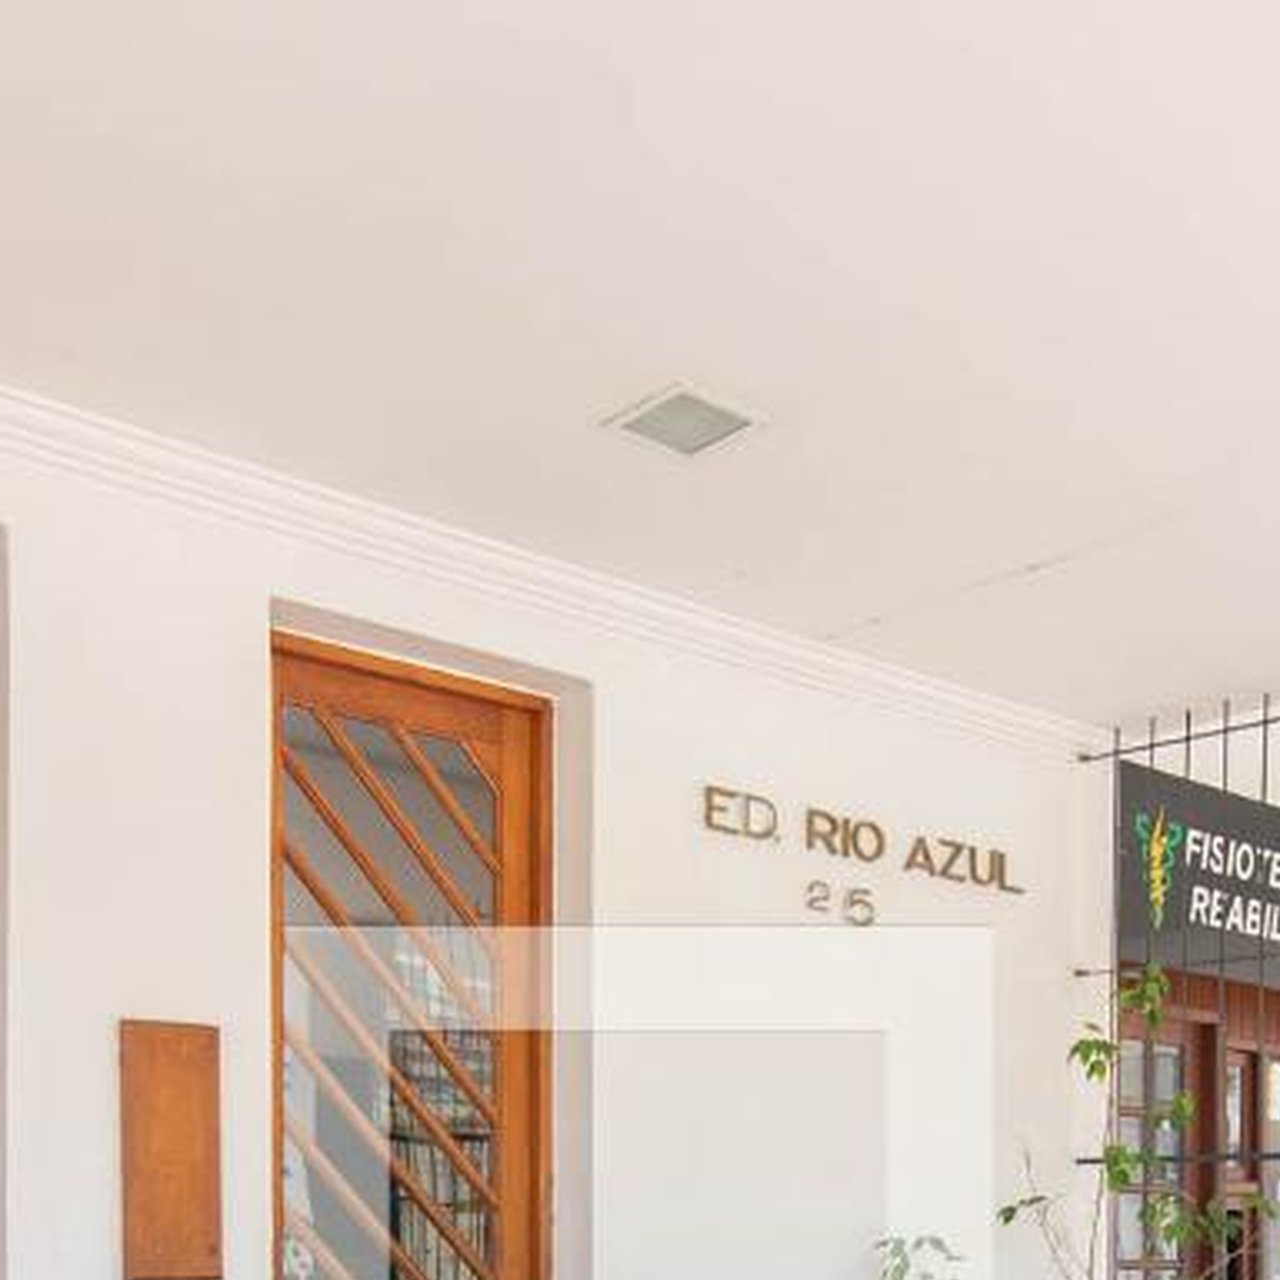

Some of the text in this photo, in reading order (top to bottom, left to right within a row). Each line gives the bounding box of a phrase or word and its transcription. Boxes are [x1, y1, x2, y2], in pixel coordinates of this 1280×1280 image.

[806, 808, 885, 862] RIO
[903, 836, 1025, 895] AZUL
[806, 879, 874, 928] 25
